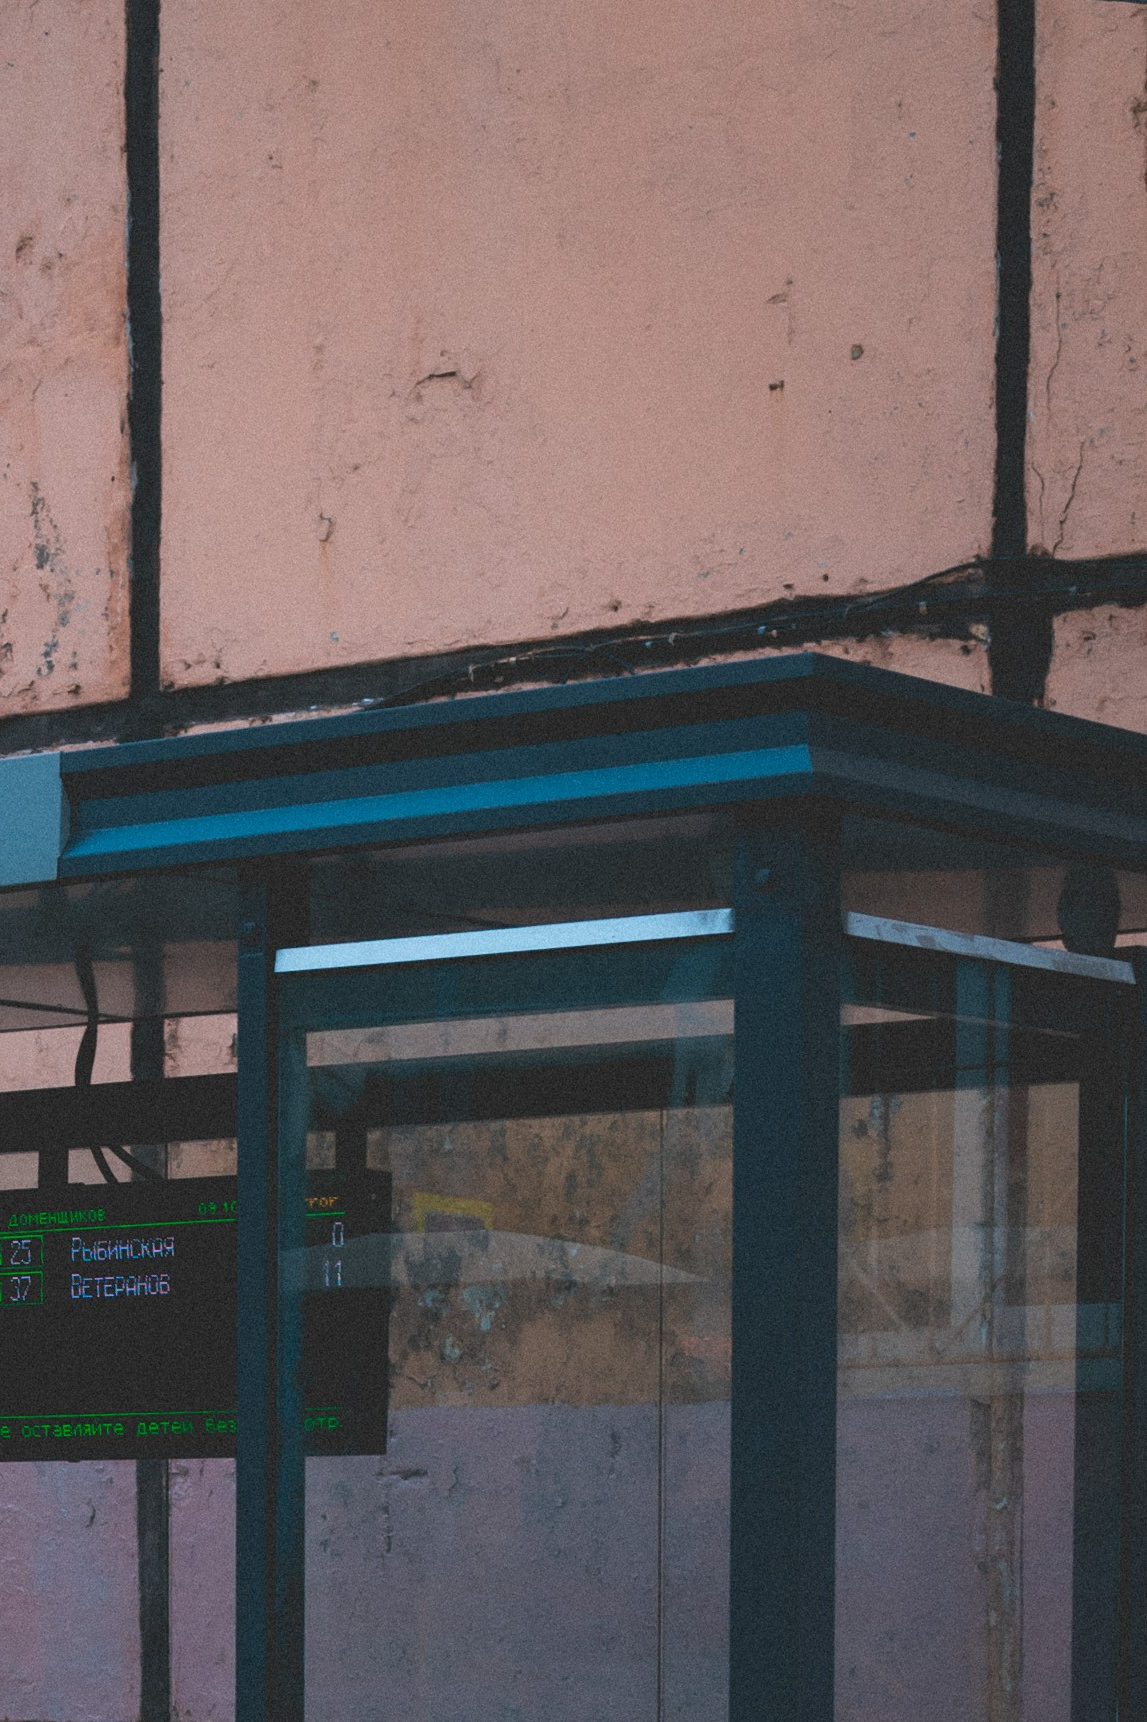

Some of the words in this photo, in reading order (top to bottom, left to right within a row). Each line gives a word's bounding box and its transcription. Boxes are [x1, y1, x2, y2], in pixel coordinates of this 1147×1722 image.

[9, 1239, 32, 1266] 25
[9, 1275, 32, 1302] 37
[323, 1259, 343, 1288] 11
